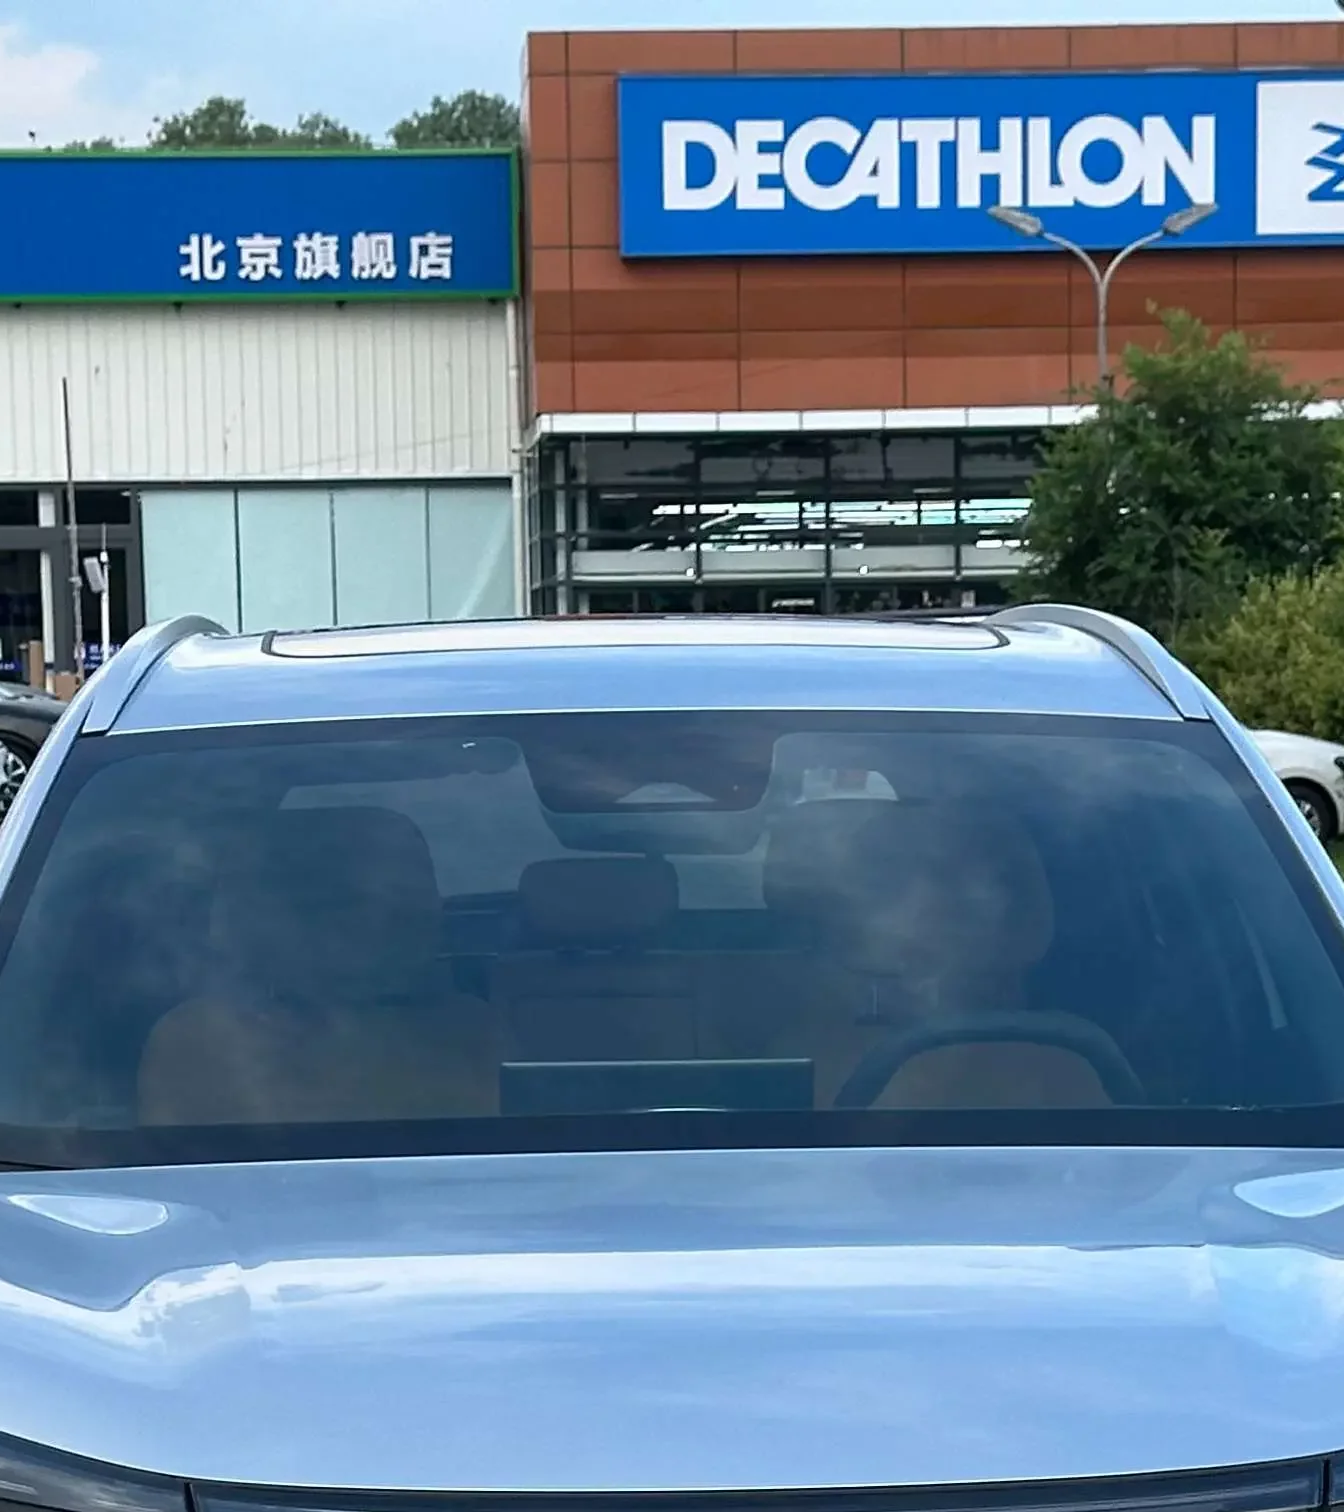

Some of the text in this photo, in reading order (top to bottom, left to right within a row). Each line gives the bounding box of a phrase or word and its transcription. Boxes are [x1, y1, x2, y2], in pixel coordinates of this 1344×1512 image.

[662, 115, 1216, 211] DECATHLON
[179, 232, 454, 281] 北京旗舰店
